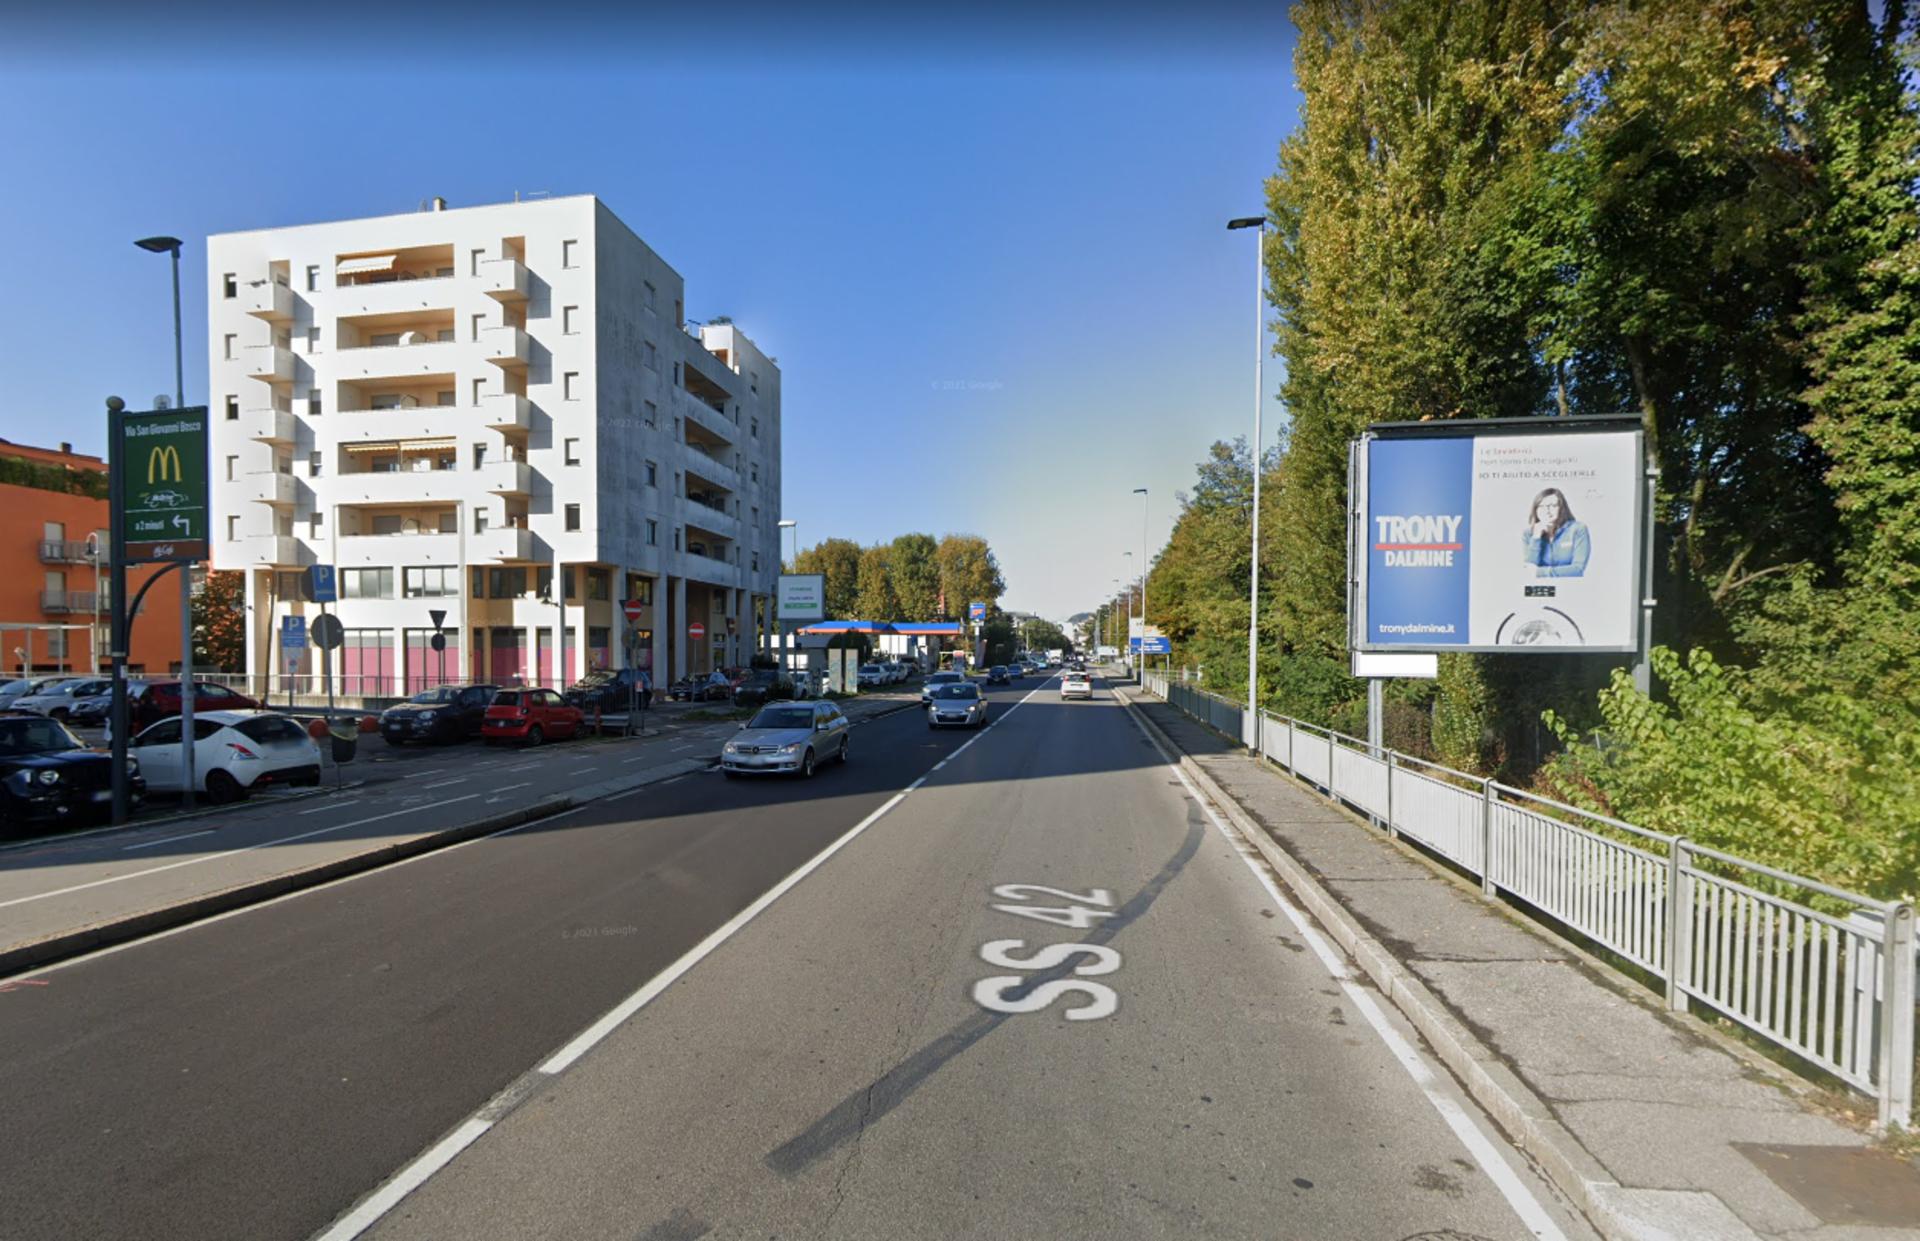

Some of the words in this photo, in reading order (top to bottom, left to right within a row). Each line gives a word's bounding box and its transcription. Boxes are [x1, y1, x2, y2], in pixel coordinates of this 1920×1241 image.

[1375, 514, 1463, 544] TRONY
[1385, 550, 1454, 567] DALMINE
[319, 567, 330, 583] P
[288, 617, 299, 631] P
[1379, 622, 1456, 636] tronydalmine.it
[973, 939, 1122, 1021] SS
